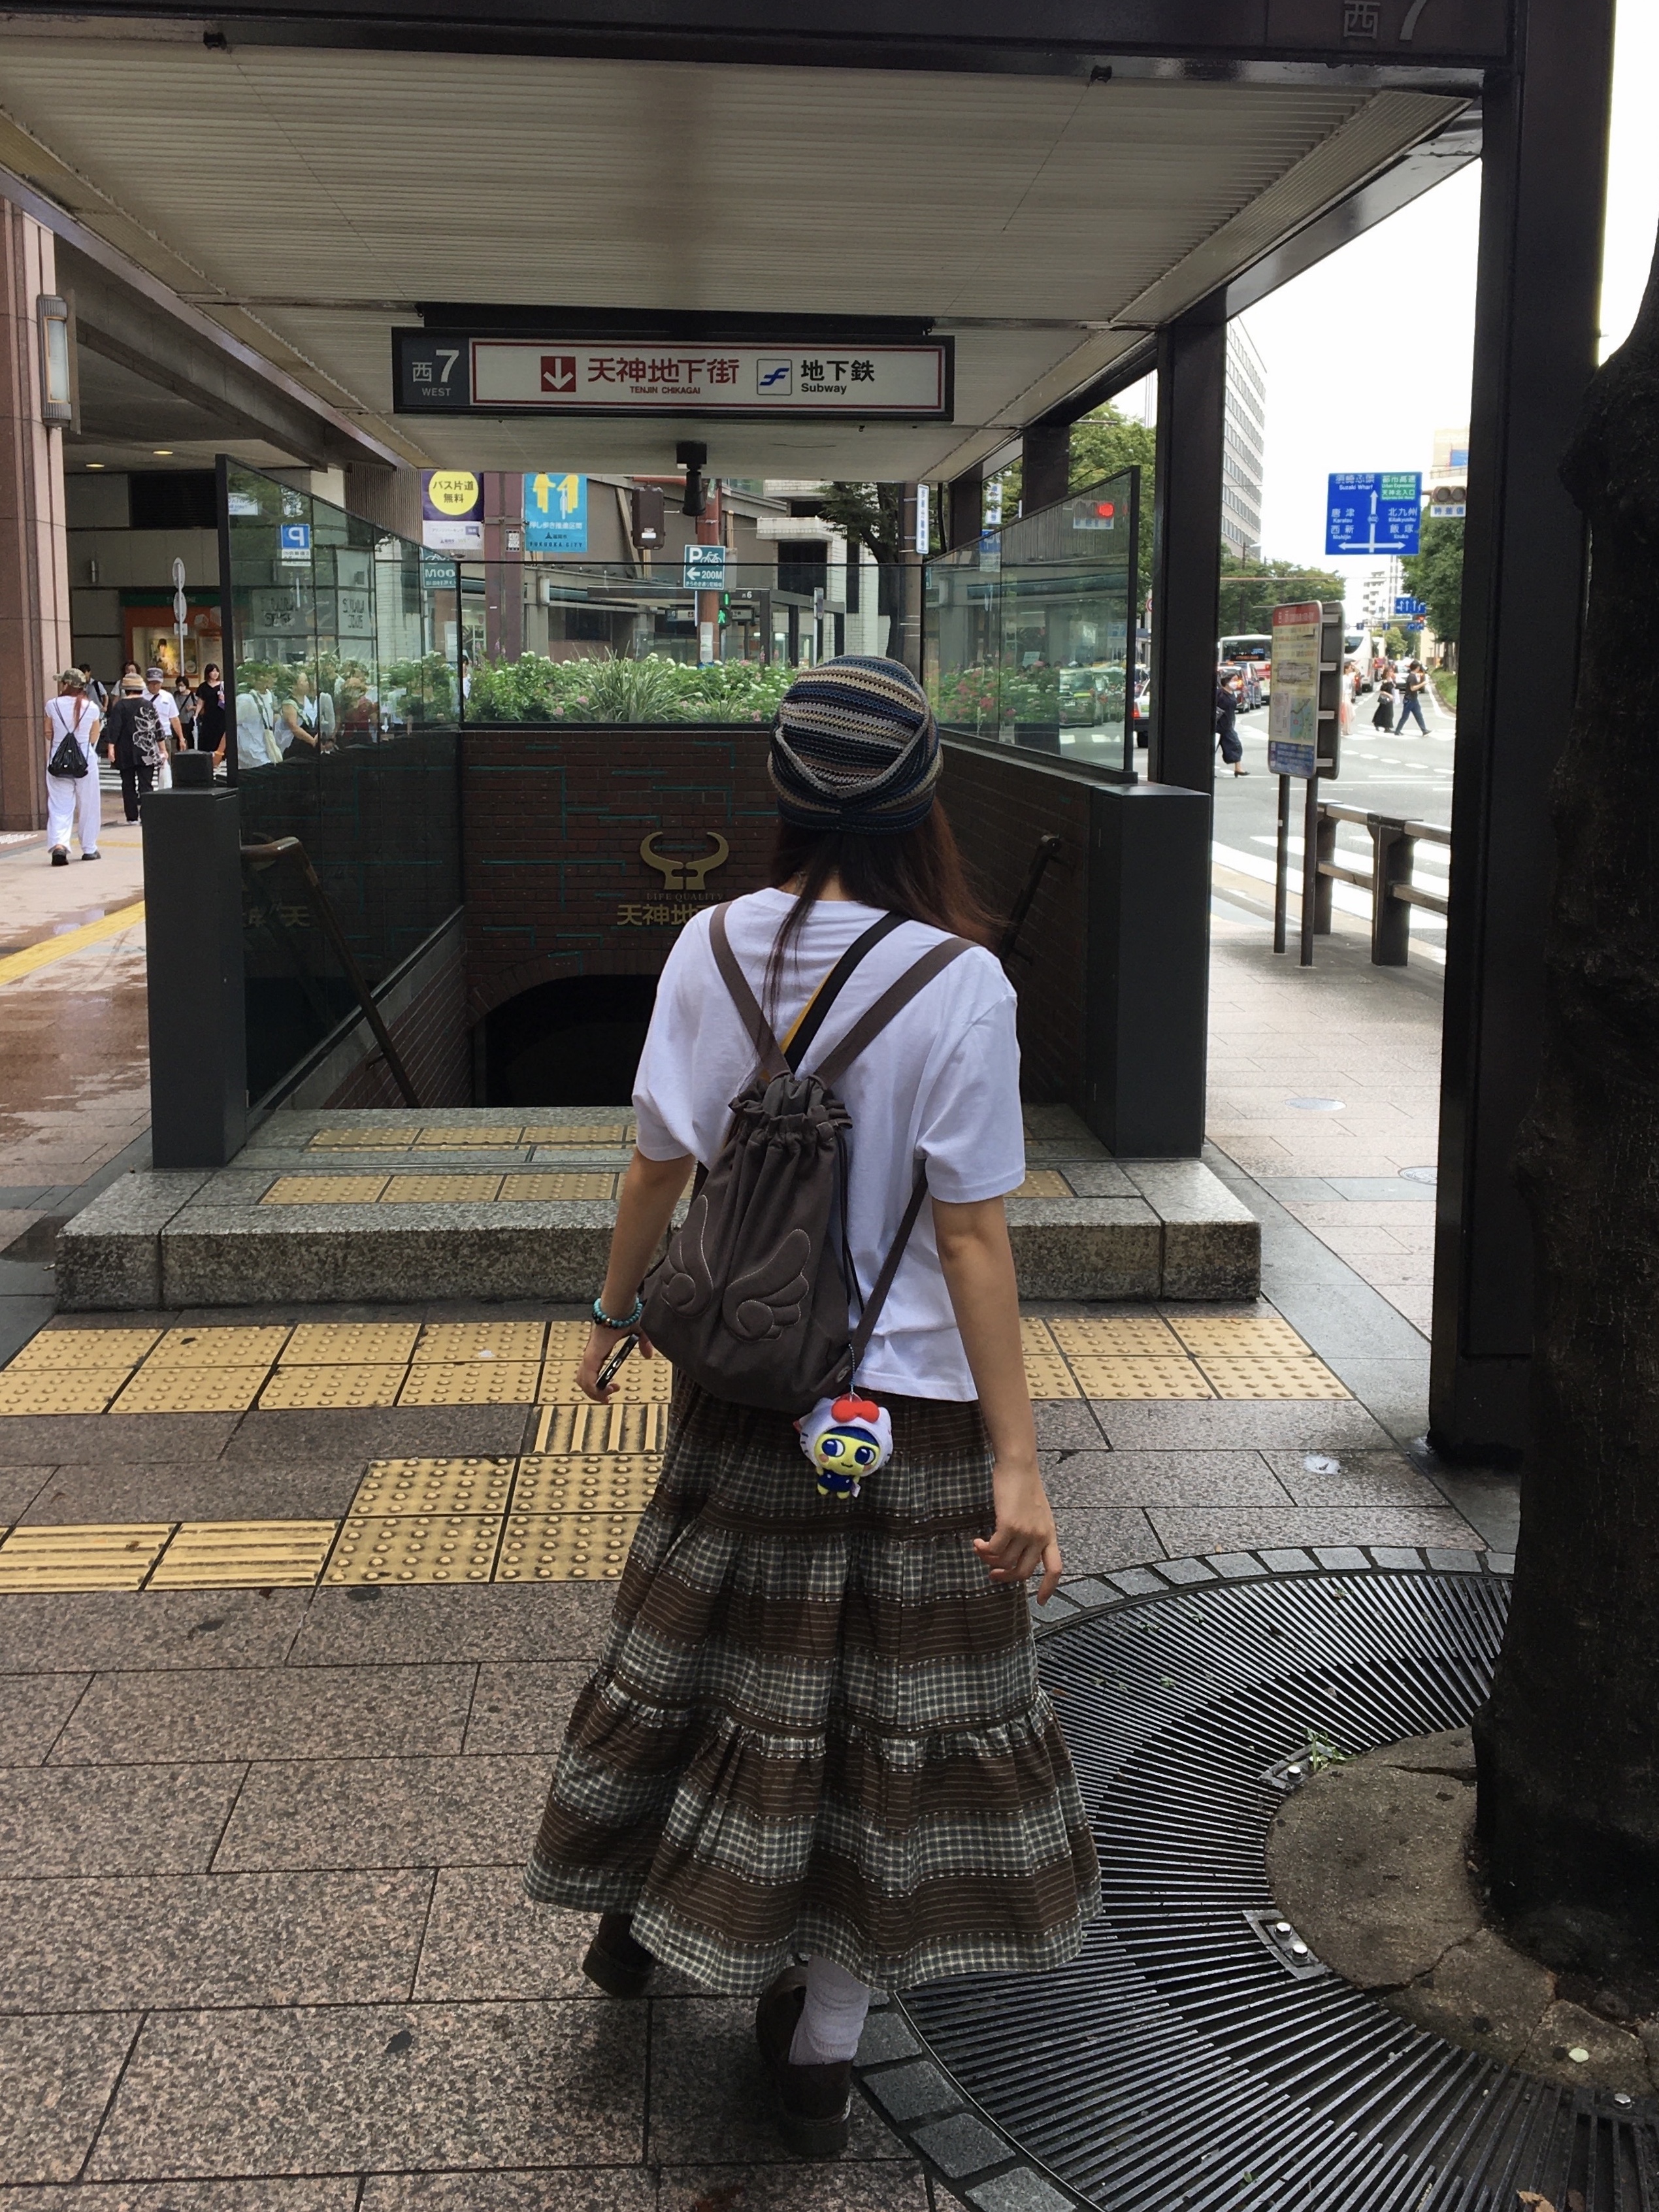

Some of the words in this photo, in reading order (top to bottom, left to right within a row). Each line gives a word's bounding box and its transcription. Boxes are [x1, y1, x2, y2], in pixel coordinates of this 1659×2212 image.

[588, 357, 740, 384] 天神地下街
[801, 359, 875, 382] 地下鉄
[421, 387, 452, 397] WEST
[629, 386, 658, 394] TENJIN
[661, 386, 700, 395] CHIKAGAI
[801, 383, 847, 395] Subway
[433, 480, 474, 491] バス片道
[443, 493, 464, 503] 無料
[1388, 507, 1417, 516] 北九州
[689, 547, 702, 563] P
[701, 570, 723, 579] 200M
[675, 893, 723, 902] QUALITY
[617, 904, 709, 925] 天神地
